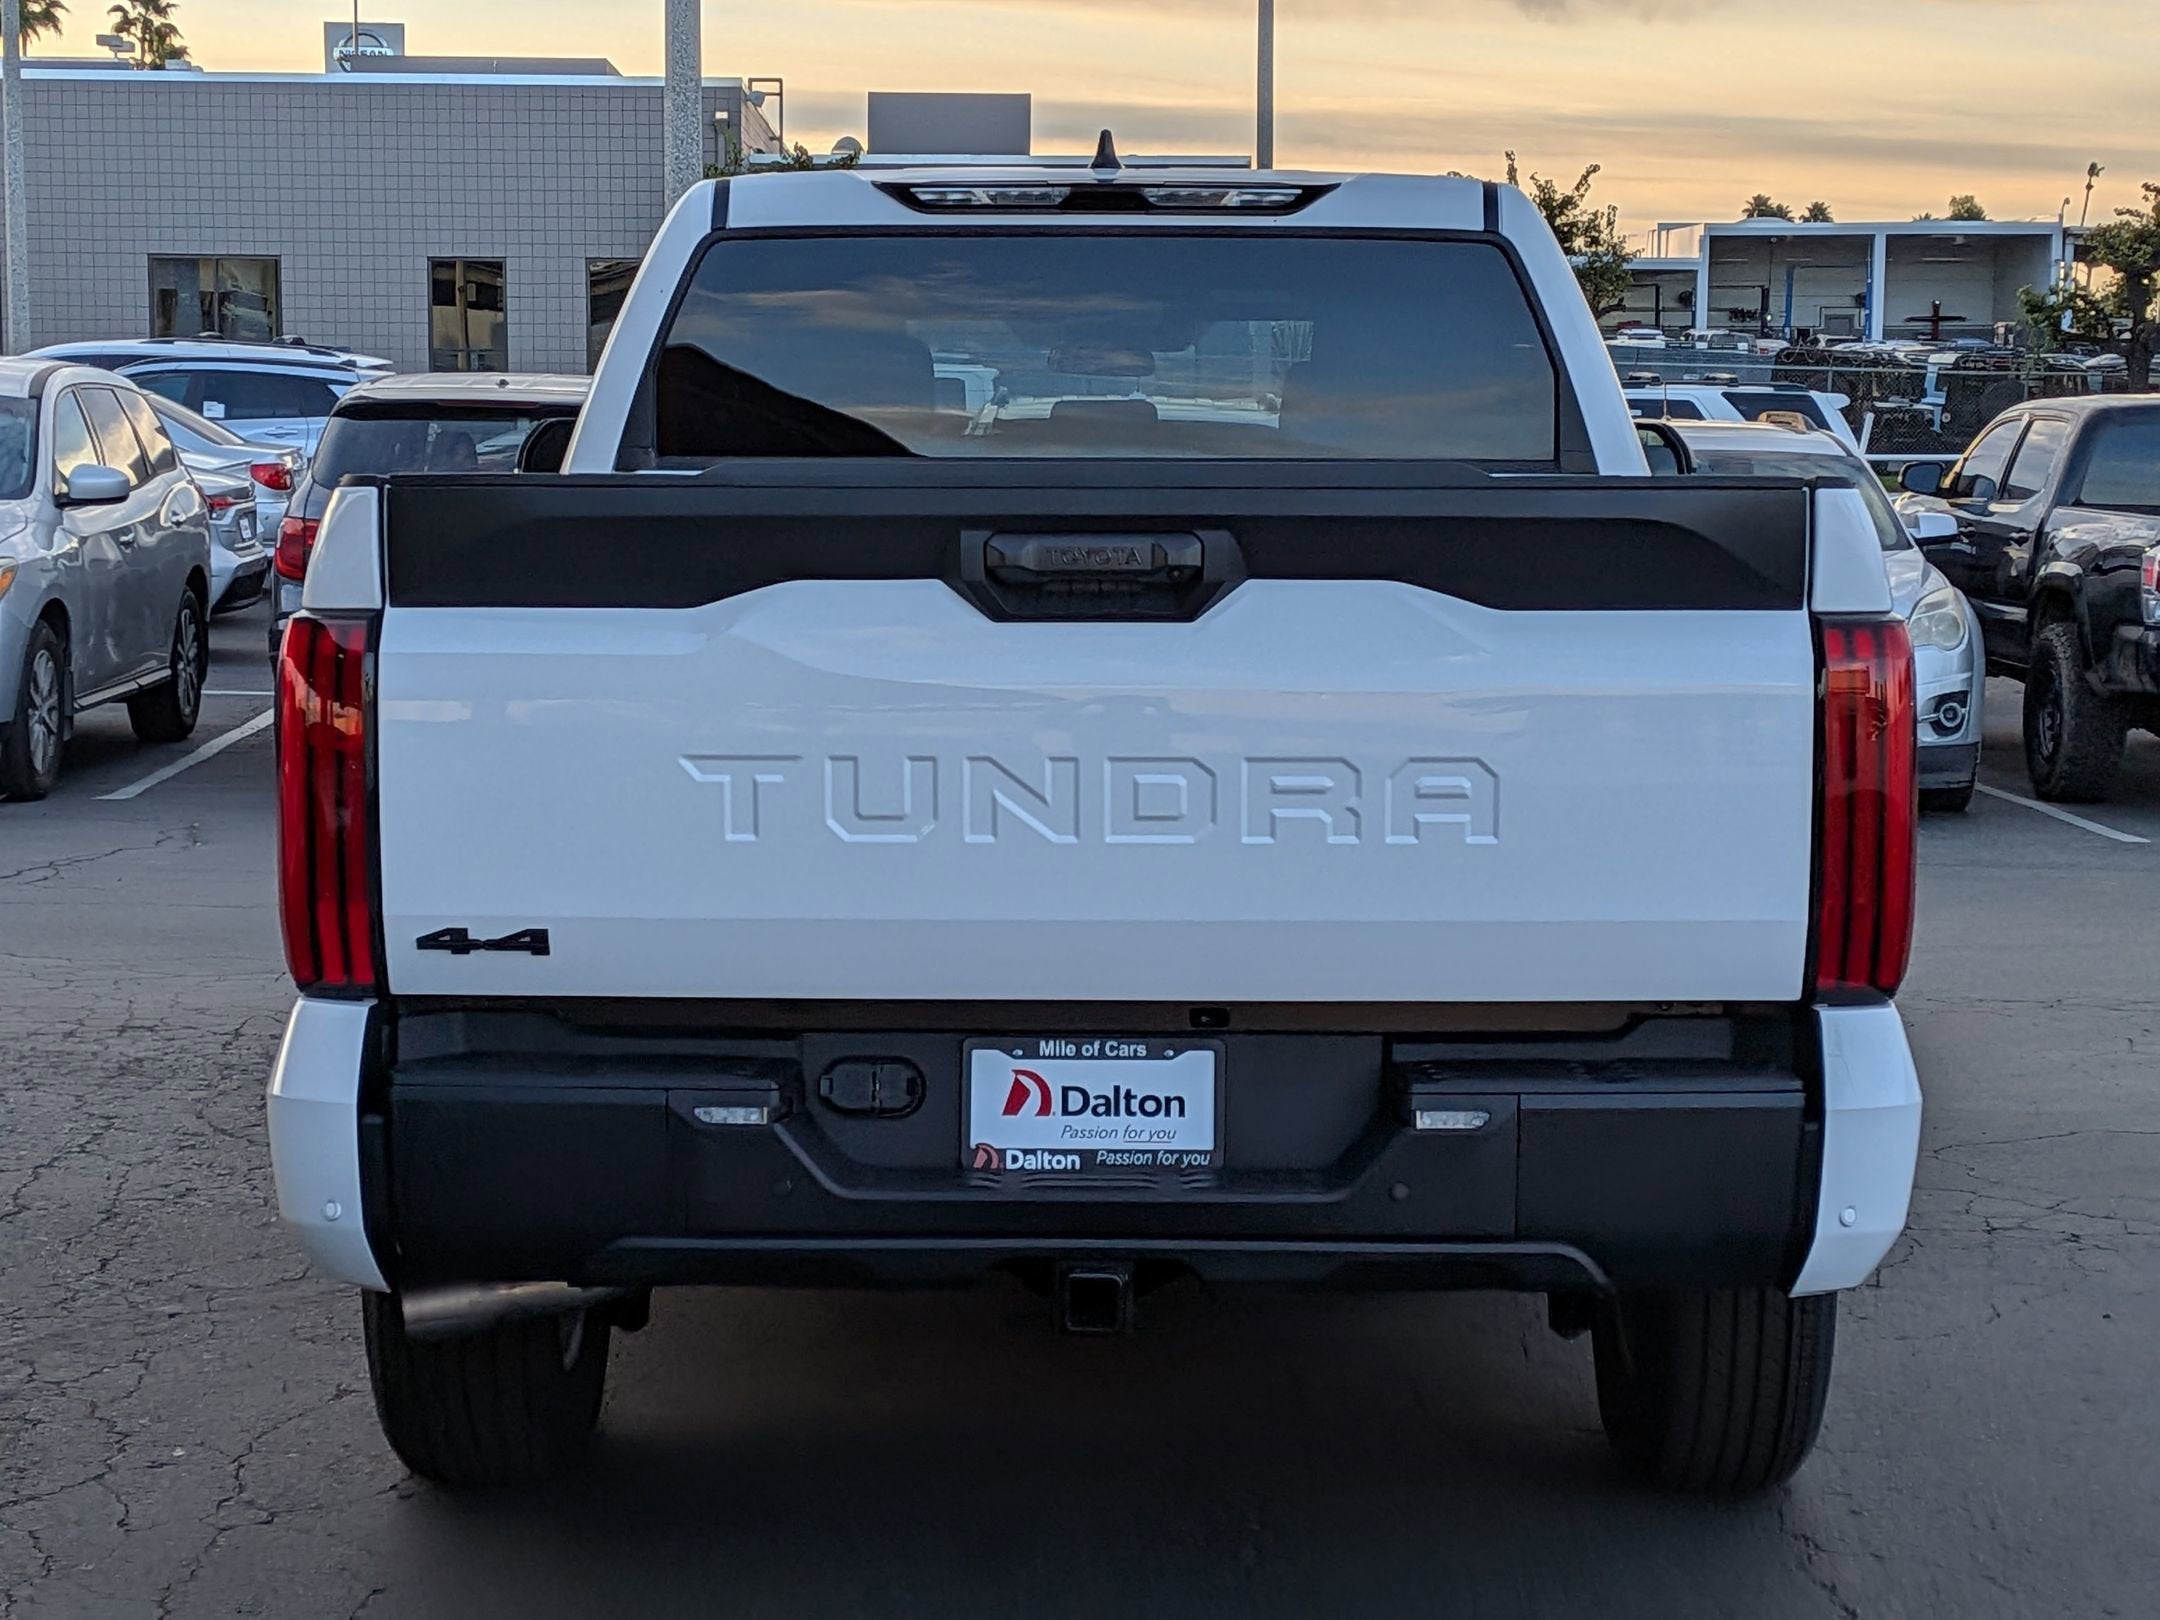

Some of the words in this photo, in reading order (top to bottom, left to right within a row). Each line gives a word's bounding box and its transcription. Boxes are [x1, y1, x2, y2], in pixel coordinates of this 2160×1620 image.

[1047, 545, 1143, 566] TOYOTA
[678, 754, 1500, 845] TUNDRA
[1039, 1040, 1076, 1057] Mile
[1081, 1040, 1100, 1057] of
[1105, 1040, 1147, 1057] Cars
[1060, 1085, 1186, 1118] Dalton
[1060, 1124, 1118, 1140] Passion
[1123, 1124, 1144, 1140] for
[1148, 1128, 1177, 1142] you
[1005, 1149, 1081, 1170] Dalton
[1096, 1150, 1153, 1166] Passion
[1156, 1149, 1179, 1166] for
[1182, 1153, 1211, 1169] you
